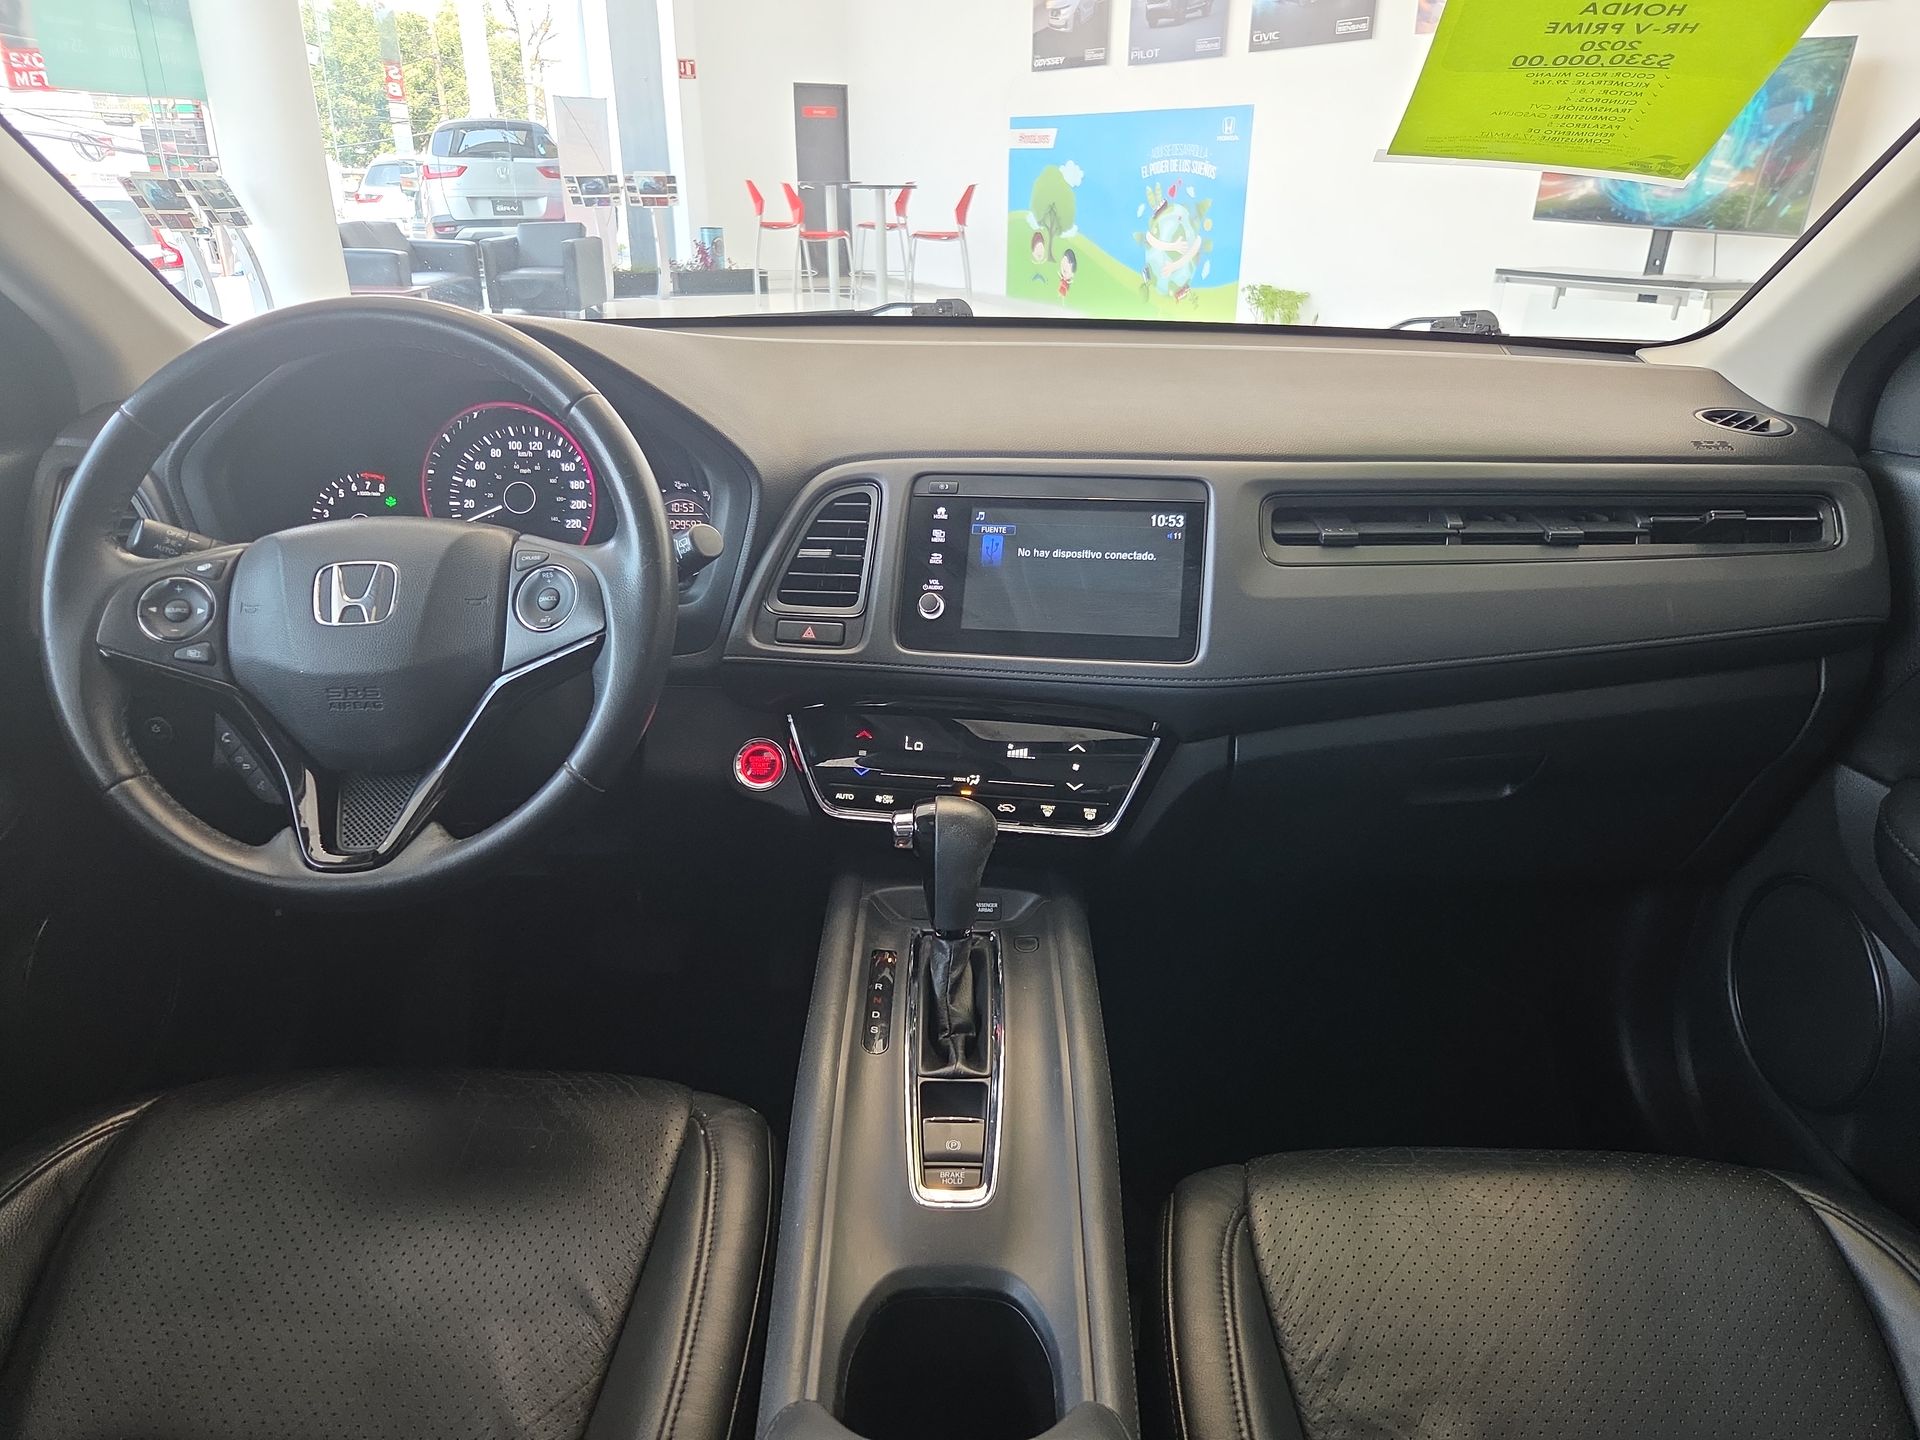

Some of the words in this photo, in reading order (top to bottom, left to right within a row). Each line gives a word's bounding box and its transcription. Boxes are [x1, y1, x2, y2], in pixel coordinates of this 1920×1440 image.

[1252, 31, 1280, 42] CIVIC
[1130, 48, 1160, 60] PILOT
[1033, 56, 1066, 68] ODYSSEY
[508, 441, 522, 450] 100
[529, 441, 543, 450] 120
[491, 449, 502, 458] 80
[517, 450, 533, 458] km/h
[547, 449, 561, 459] 140
[474, 461, 486, 470] 60
[560, 462, 575, 472] 160
[351, 483, 357, 492] 6
[364, 481, 371, 490] 7
[378, 483, 385, 492] 8
[465, 479, 476, 488] 40
[569, 481, 585, 490] 180
[338, 489, 345, 498] 5
[328, 497, 334, 506] 4
[464, 499, 475, 509] 20
[569, 500, 587, 509] 200
[671, 502, 694, 513] 10:53
[323, 509, 329, 518] 3
[565, 519, 582, 528] 220
[1150, 514, 1184, 528] 10:53
[981, 526, 1007, 534] FUENTE
[1173, 532, 1182, 540] 11
[1017, 547, 1031, 557] No
[1033, 547, 1050, 559] hay
[1052, 547, 1102, 560] dispositivo
[1104, 550, 1157, 561] conectado.
[541, 571, 554, 579] RES
[904, 735, 924, 751] Lo
[835, 792, 855, 801] AUTO
[871, 1010, 880, 1019] D
[870, 1025, 879, 1034] S
[941, 1177, 963, 1185] HOLD
